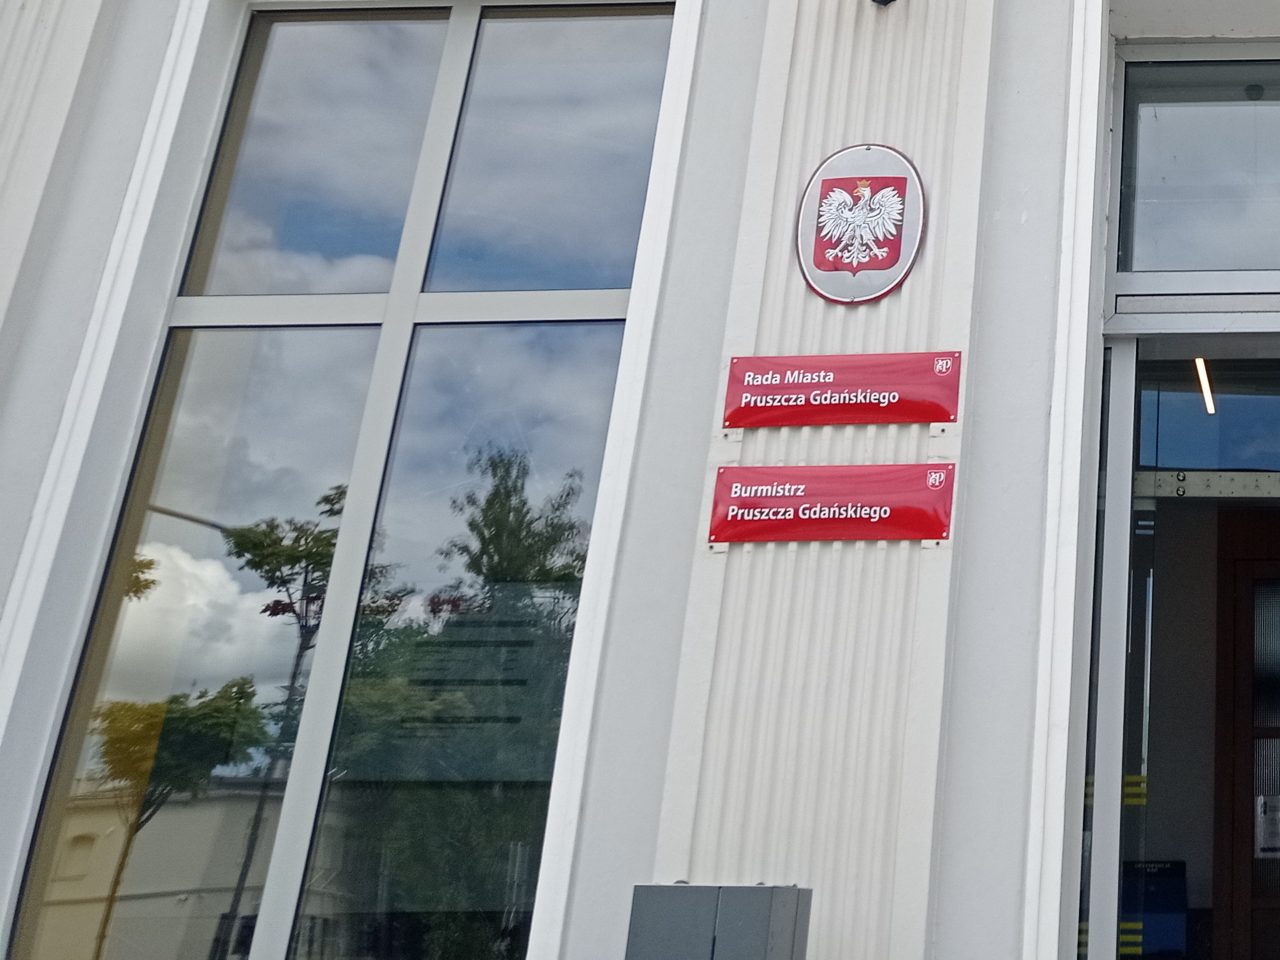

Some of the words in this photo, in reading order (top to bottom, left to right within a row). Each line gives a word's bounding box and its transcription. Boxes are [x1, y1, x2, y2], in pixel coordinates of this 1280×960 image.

[743, 371, 781, 386] Rada
[784, 370, 834, 384] Miasta
[740, 391, 806, 407] Pruszcza
[809, 389, 899, 406] Gdańskiego
[730, 482, 806, 498] Burmistrz
[727, 505, 794, 520] Pruszcza
[797, 503, 891, 522] Gdańskiego
